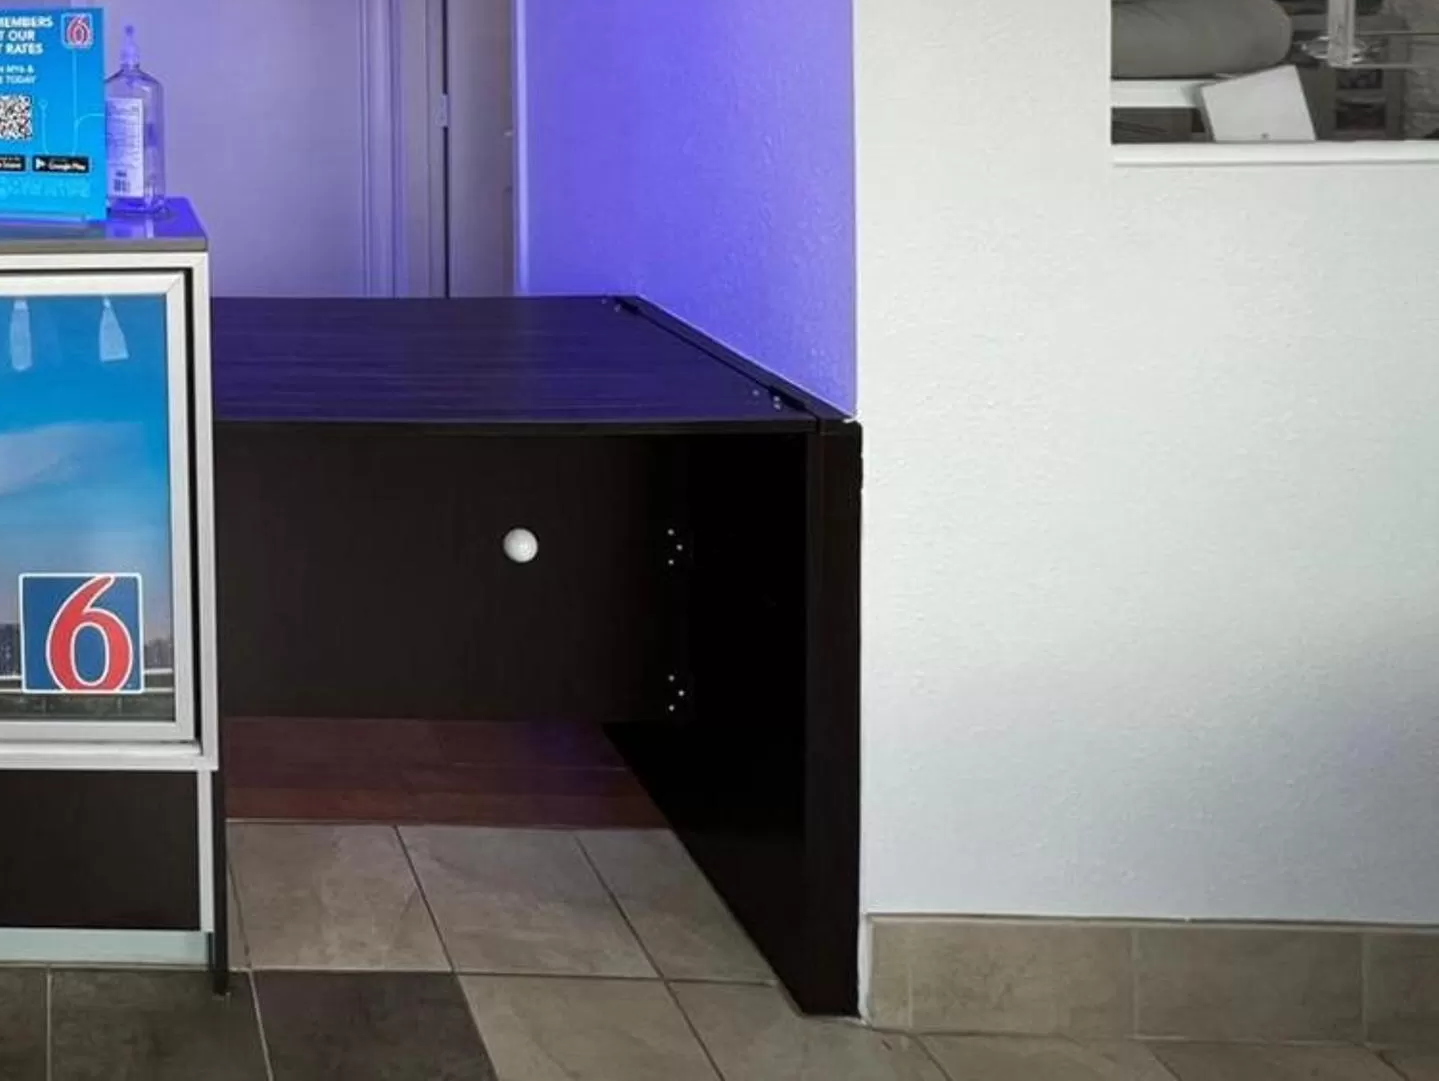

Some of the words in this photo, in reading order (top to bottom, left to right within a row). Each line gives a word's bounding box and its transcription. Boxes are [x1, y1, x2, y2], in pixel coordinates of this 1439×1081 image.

[8, 30, 35, 41] OUR
[6, 43, 44, 55] RATES
[6, 75, 36, 84] TODAY
[46, 573, 134, 693] 6
